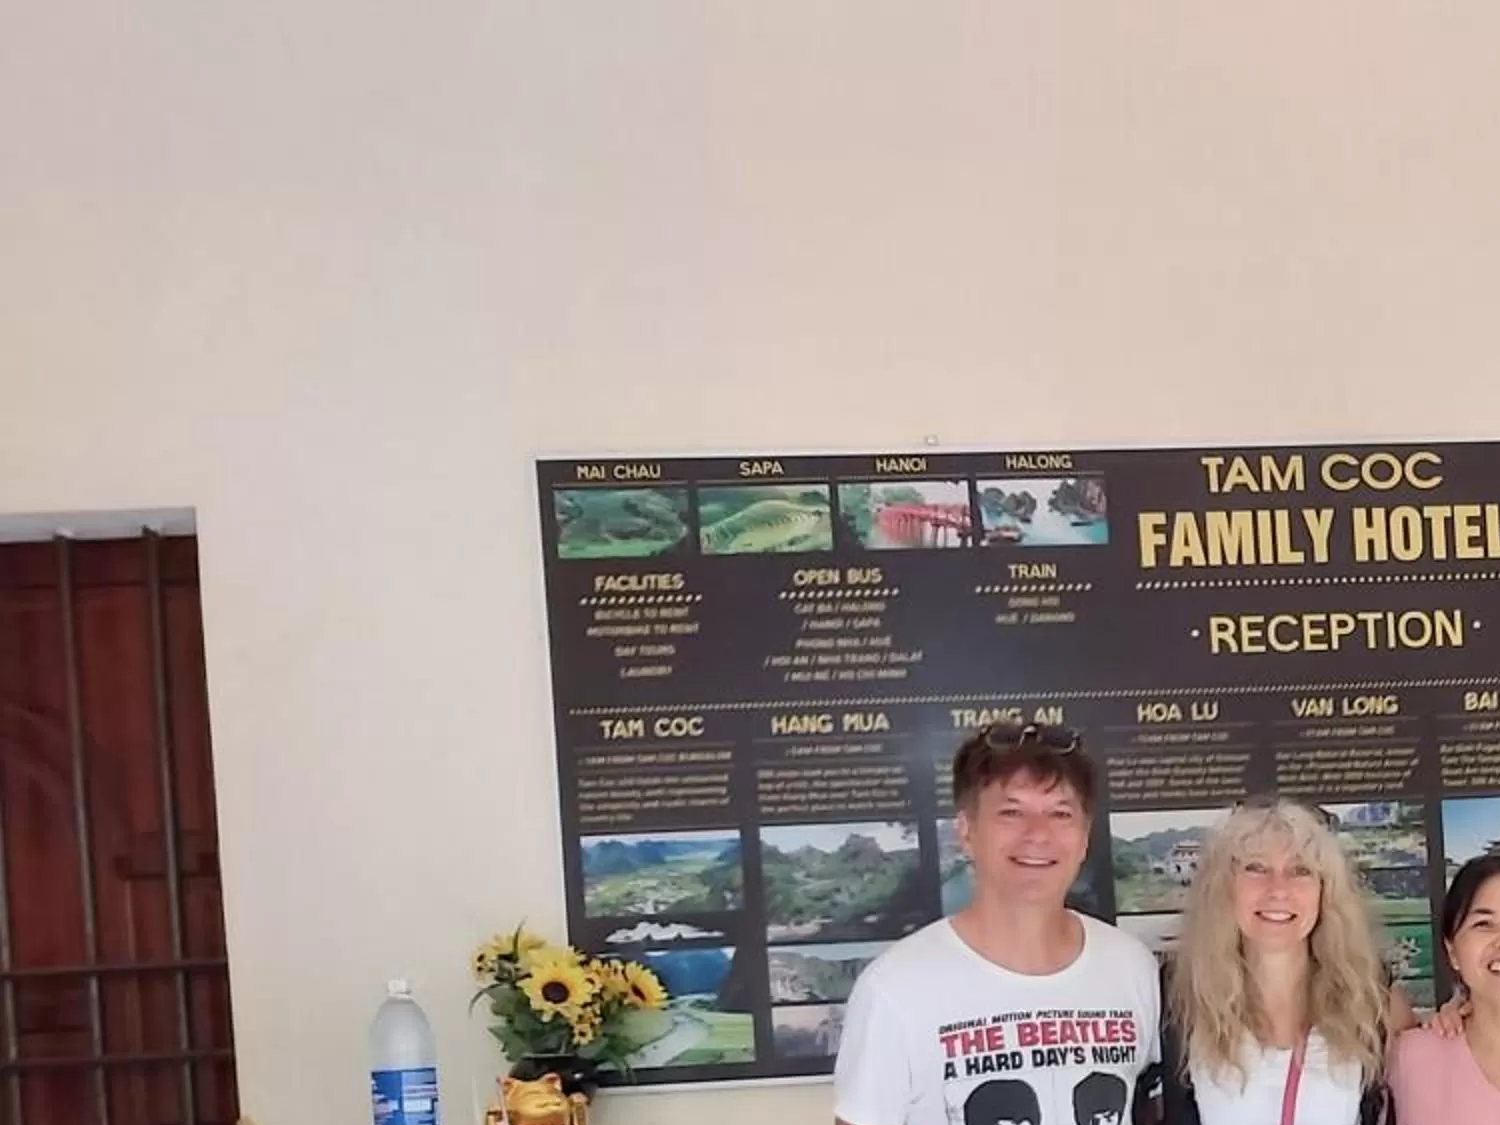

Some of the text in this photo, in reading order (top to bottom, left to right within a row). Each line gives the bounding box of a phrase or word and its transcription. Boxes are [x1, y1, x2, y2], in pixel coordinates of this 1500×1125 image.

[577, 464, 662, 480] MAI CHAU
[739, 461, 784, 476] SAPA
[875, 457, 927, 472] HANOI
[1005, 454, 1073, 469] HALONG
[1201, 451, 1443, 493] TAM COC
[1137, 508, 1335, 568] FAMILY
[793, 568, 883, 585] OPEN BUS
[1007, 563, 1057, 579] TRAIN
[594, 573, 685, 592] FACILITIES
[1208, 609, 1464, 654] RECEPTION
[1137, 701, 1218, 722] HOA LU
[1292, 696, 1399, 717] VAN LONG
[1464, 692, 1498, 711] BAI
[771, 712, 890, 735] HANG MUA
[1034, 705, 1063, 725] AN
[601, 717, 704, 739] TAM COC
[939, 1009, 1133, 1034] ORIGINAL MOTION PICTURE SOUND TRACK
[940, 1020, 1137, 1058] THE BEATLES
[943, 1046, 1136, 1080] A HARD DAY'S NIGHT
